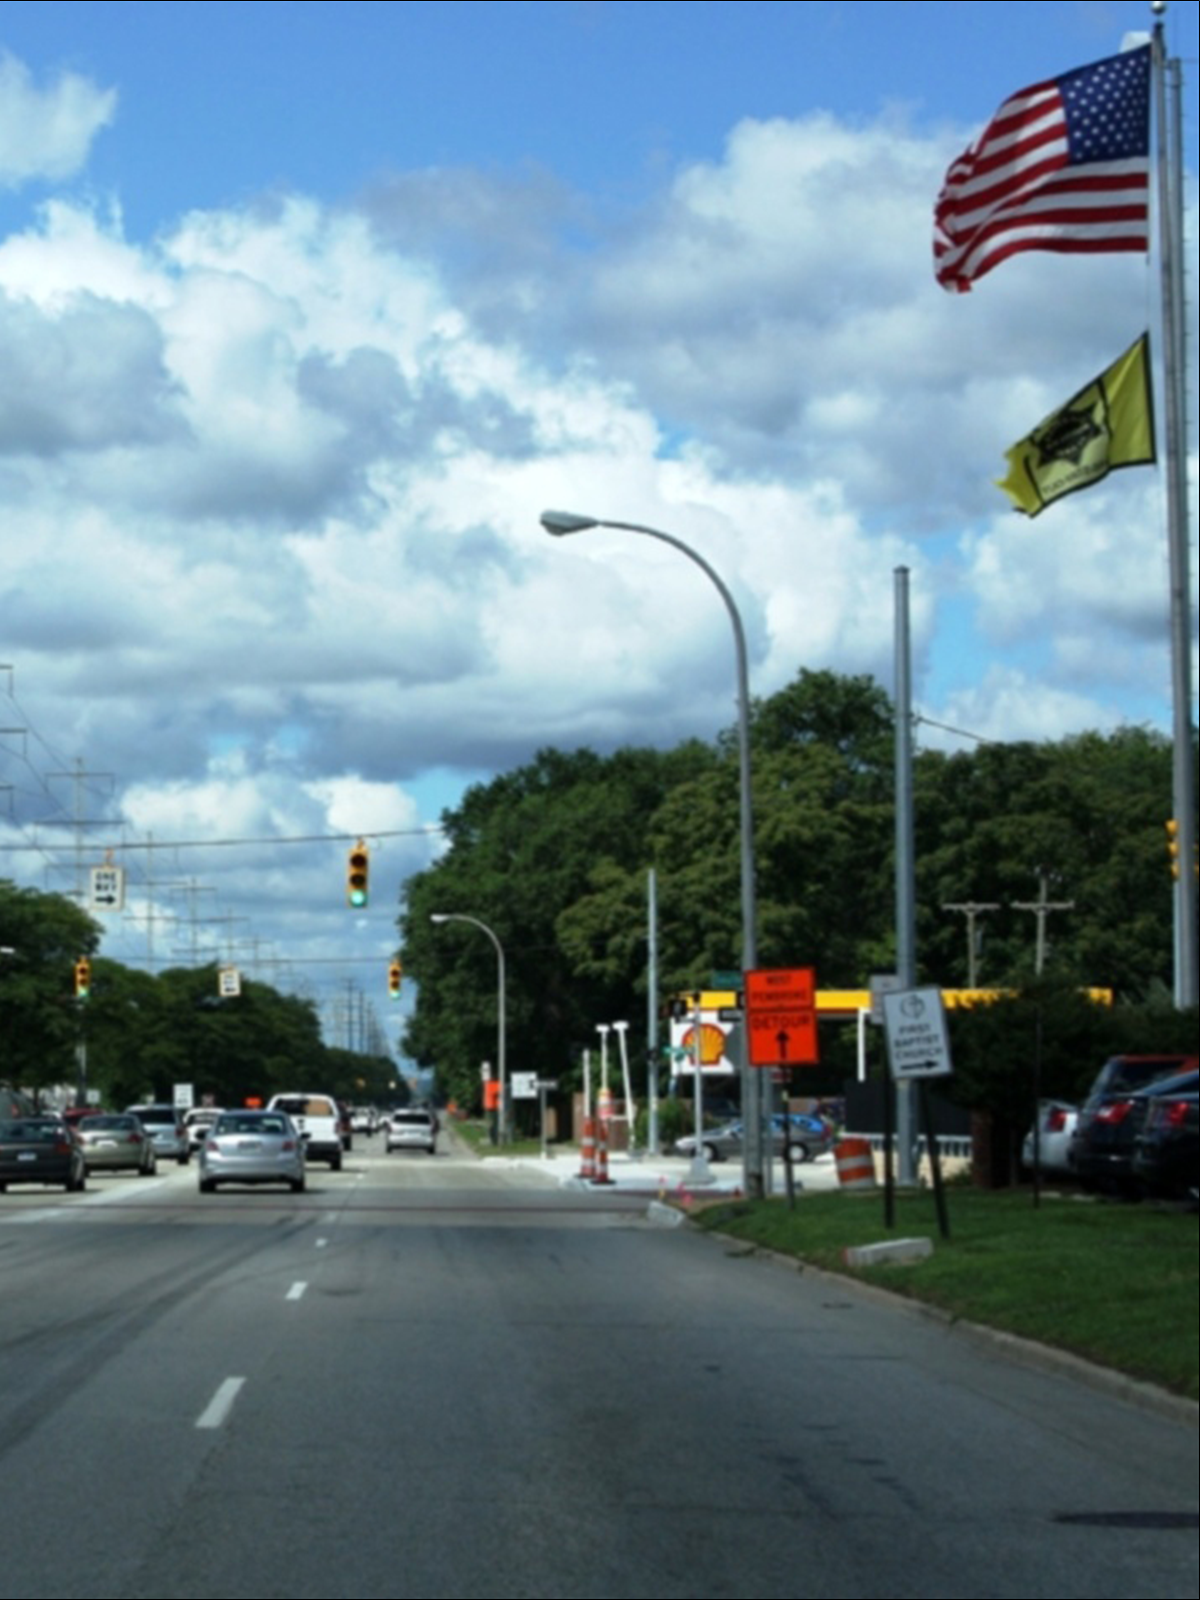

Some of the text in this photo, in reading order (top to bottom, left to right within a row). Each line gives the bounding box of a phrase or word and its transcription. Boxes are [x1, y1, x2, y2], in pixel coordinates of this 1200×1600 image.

[751, 1013, 811, 1031] DETOUR
[898, 1023, 931, 1035] FIRST
[894, 1033, 940, 1048] BAPTIST
[894, 1046, 943, 1061] CHURCH
